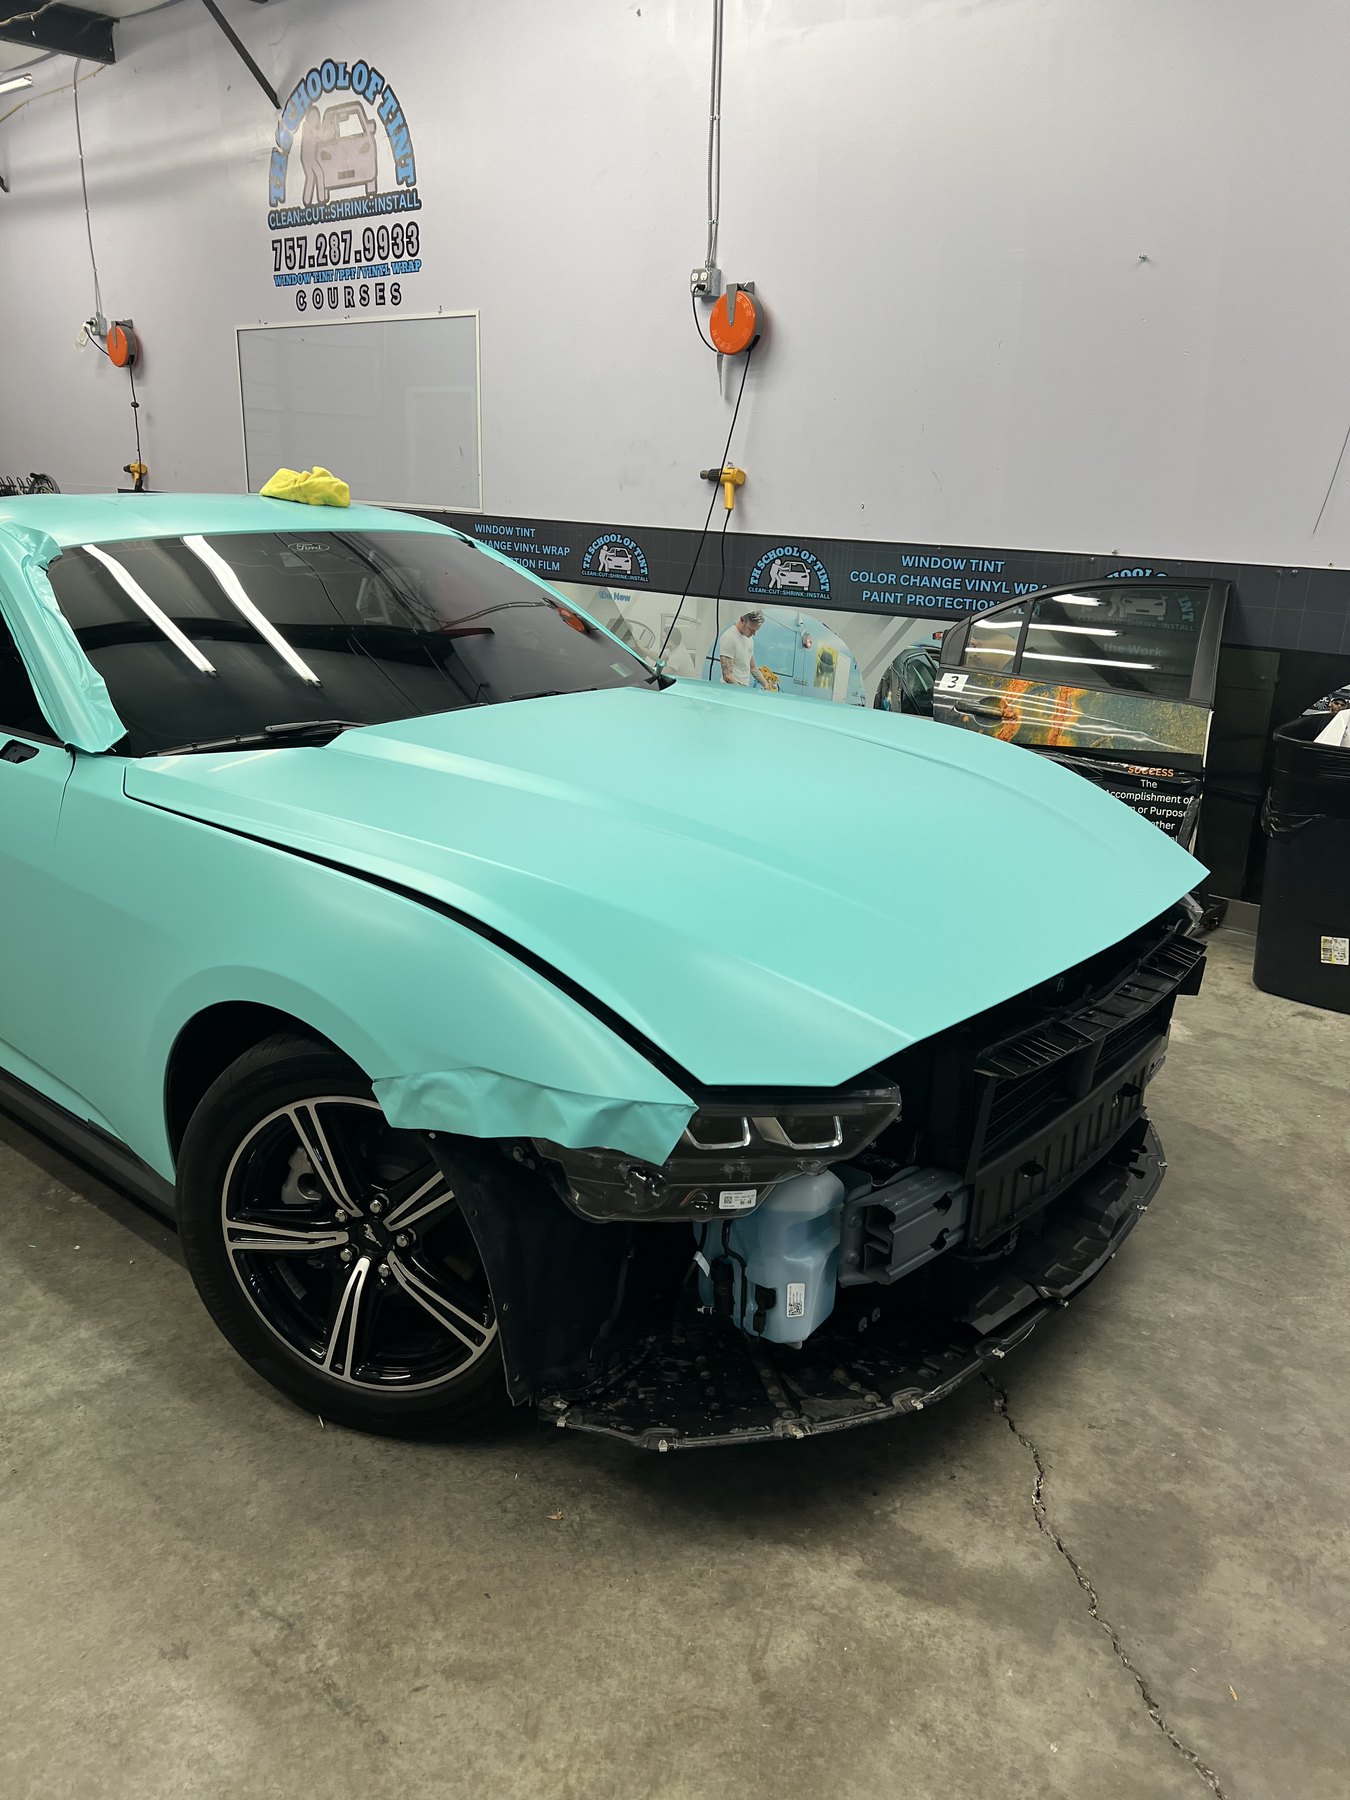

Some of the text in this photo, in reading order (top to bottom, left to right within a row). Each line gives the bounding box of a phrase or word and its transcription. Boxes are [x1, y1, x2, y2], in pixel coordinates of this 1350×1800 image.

[275, 58, 350, 152] SCHOOL
[350, 60, 384, 105] OF
[377, 84, 417, 187] TINT
[271, 221, 420, 272] 757.287.9933
[273, 273, 312, 287] WINDOW
[391, 259, 422, 274] WRAP
[295, 282, 402, 312] COURSES
[474, 523, 536, 538] WINDOW TINT
[513, 542, 540, 554] VINYL
[542, 545, 571, 556] WRAP
[583, 534, 648, 575] TH SCHOOL OF TINT
[538, 560, 560, 571] FILM
[750, 546, 830, 592] TH SCHOOL OF TINT
[901, 555, 1005, 573] WINDOW TINT
[849, 570, 1049, 595] COLOR CHANGE VINYL WR
[862, 590, 903, 605] PAINT
[947, 675, 960, 689] 3
[1127, 765, 1174, 777] SUCCESS
[1140, 780, 1158, 789] The
[1105, 789, 1194, 804] ccomplishment of
[1138, 806, 1149, 814] or
